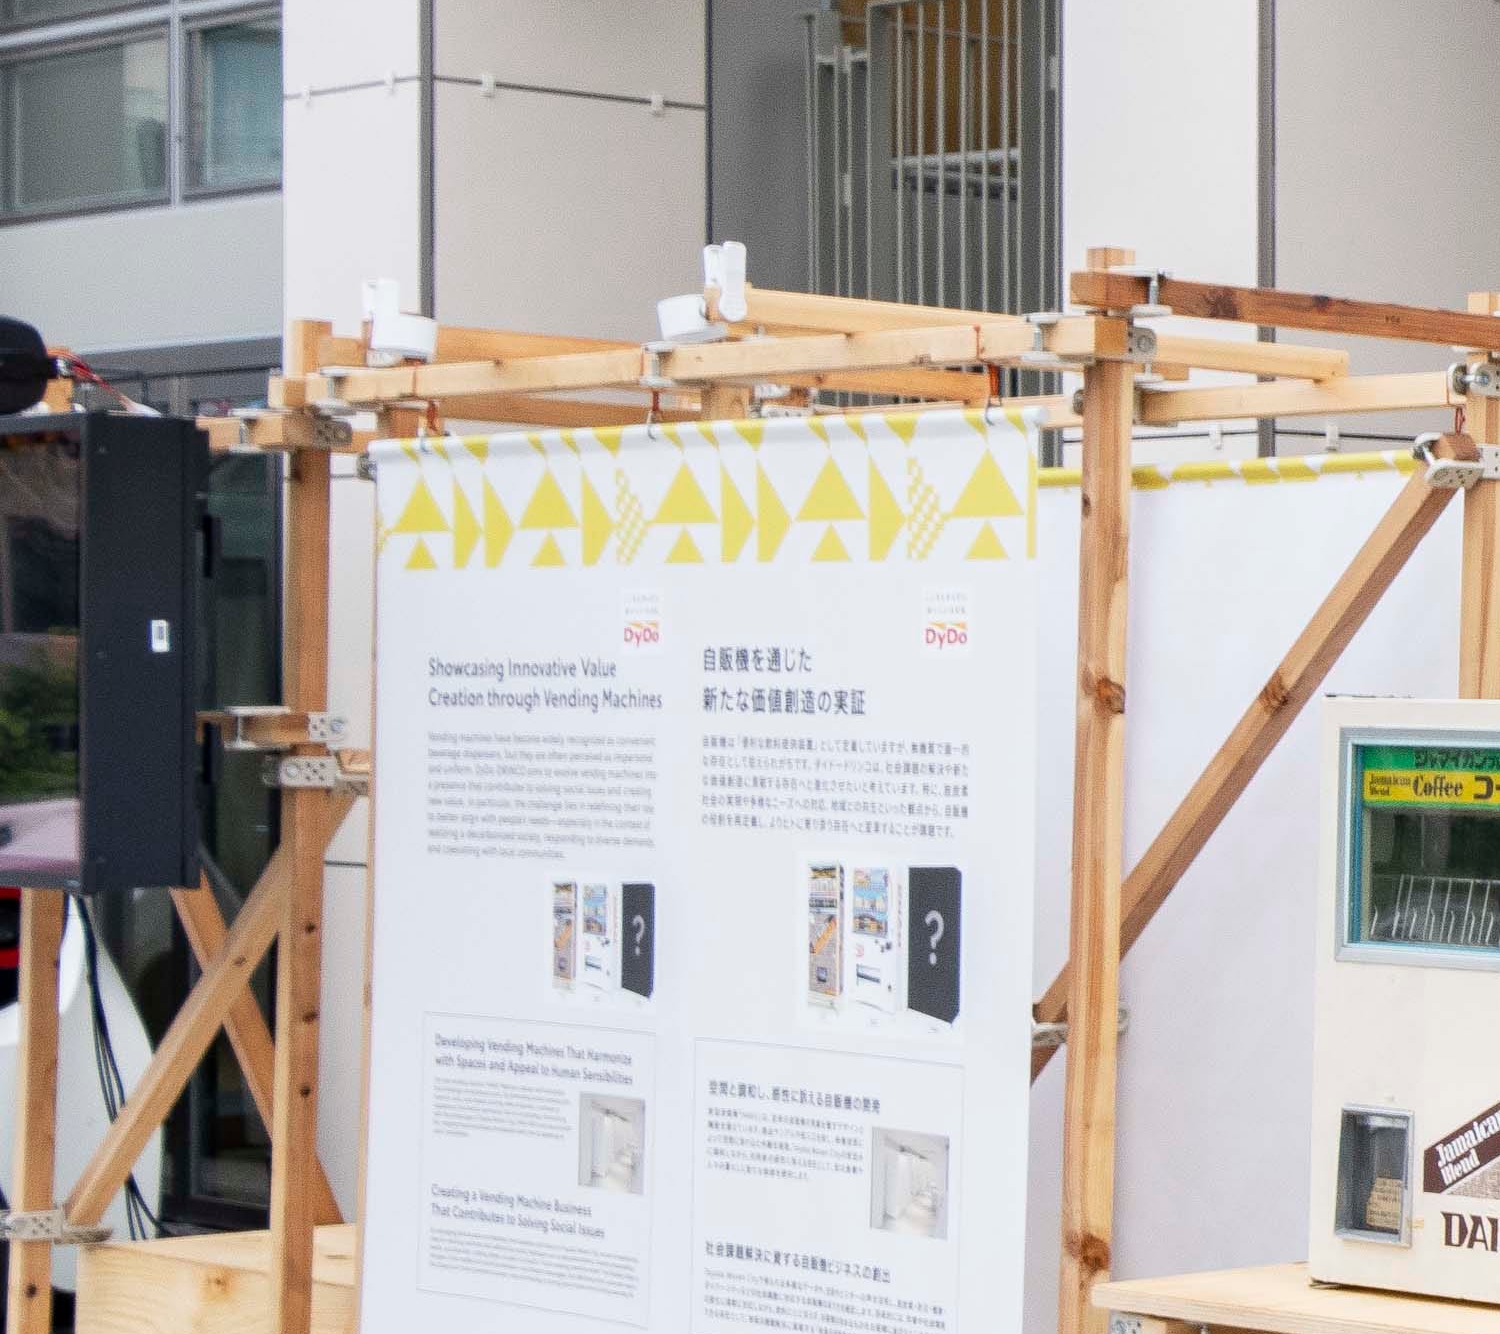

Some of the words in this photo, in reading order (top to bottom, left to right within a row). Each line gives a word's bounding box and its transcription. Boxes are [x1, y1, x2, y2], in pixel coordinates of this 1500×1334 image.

[624, 627, 660, 647] DyDo
[924, 628, 968, 649] DyDo
[428, 657, 504, 682] Showcasing
[508, 657, 577, 678] Innovative
[580, 658, 617, 678] Value
[703, 646, 813, 673] 自販機を通じた
[428, 687, 484, 708] Creation
[487, 688, 540, 713] through
[543, 687, 599, 713] Vending
[601, 689, 663, 709] Machines
[702, 686, 867, 716] 新たな価値創造の実証
[1412, 774, 1464, 798] Coffee
[1437, 1147, 1481, 1186] Blend
